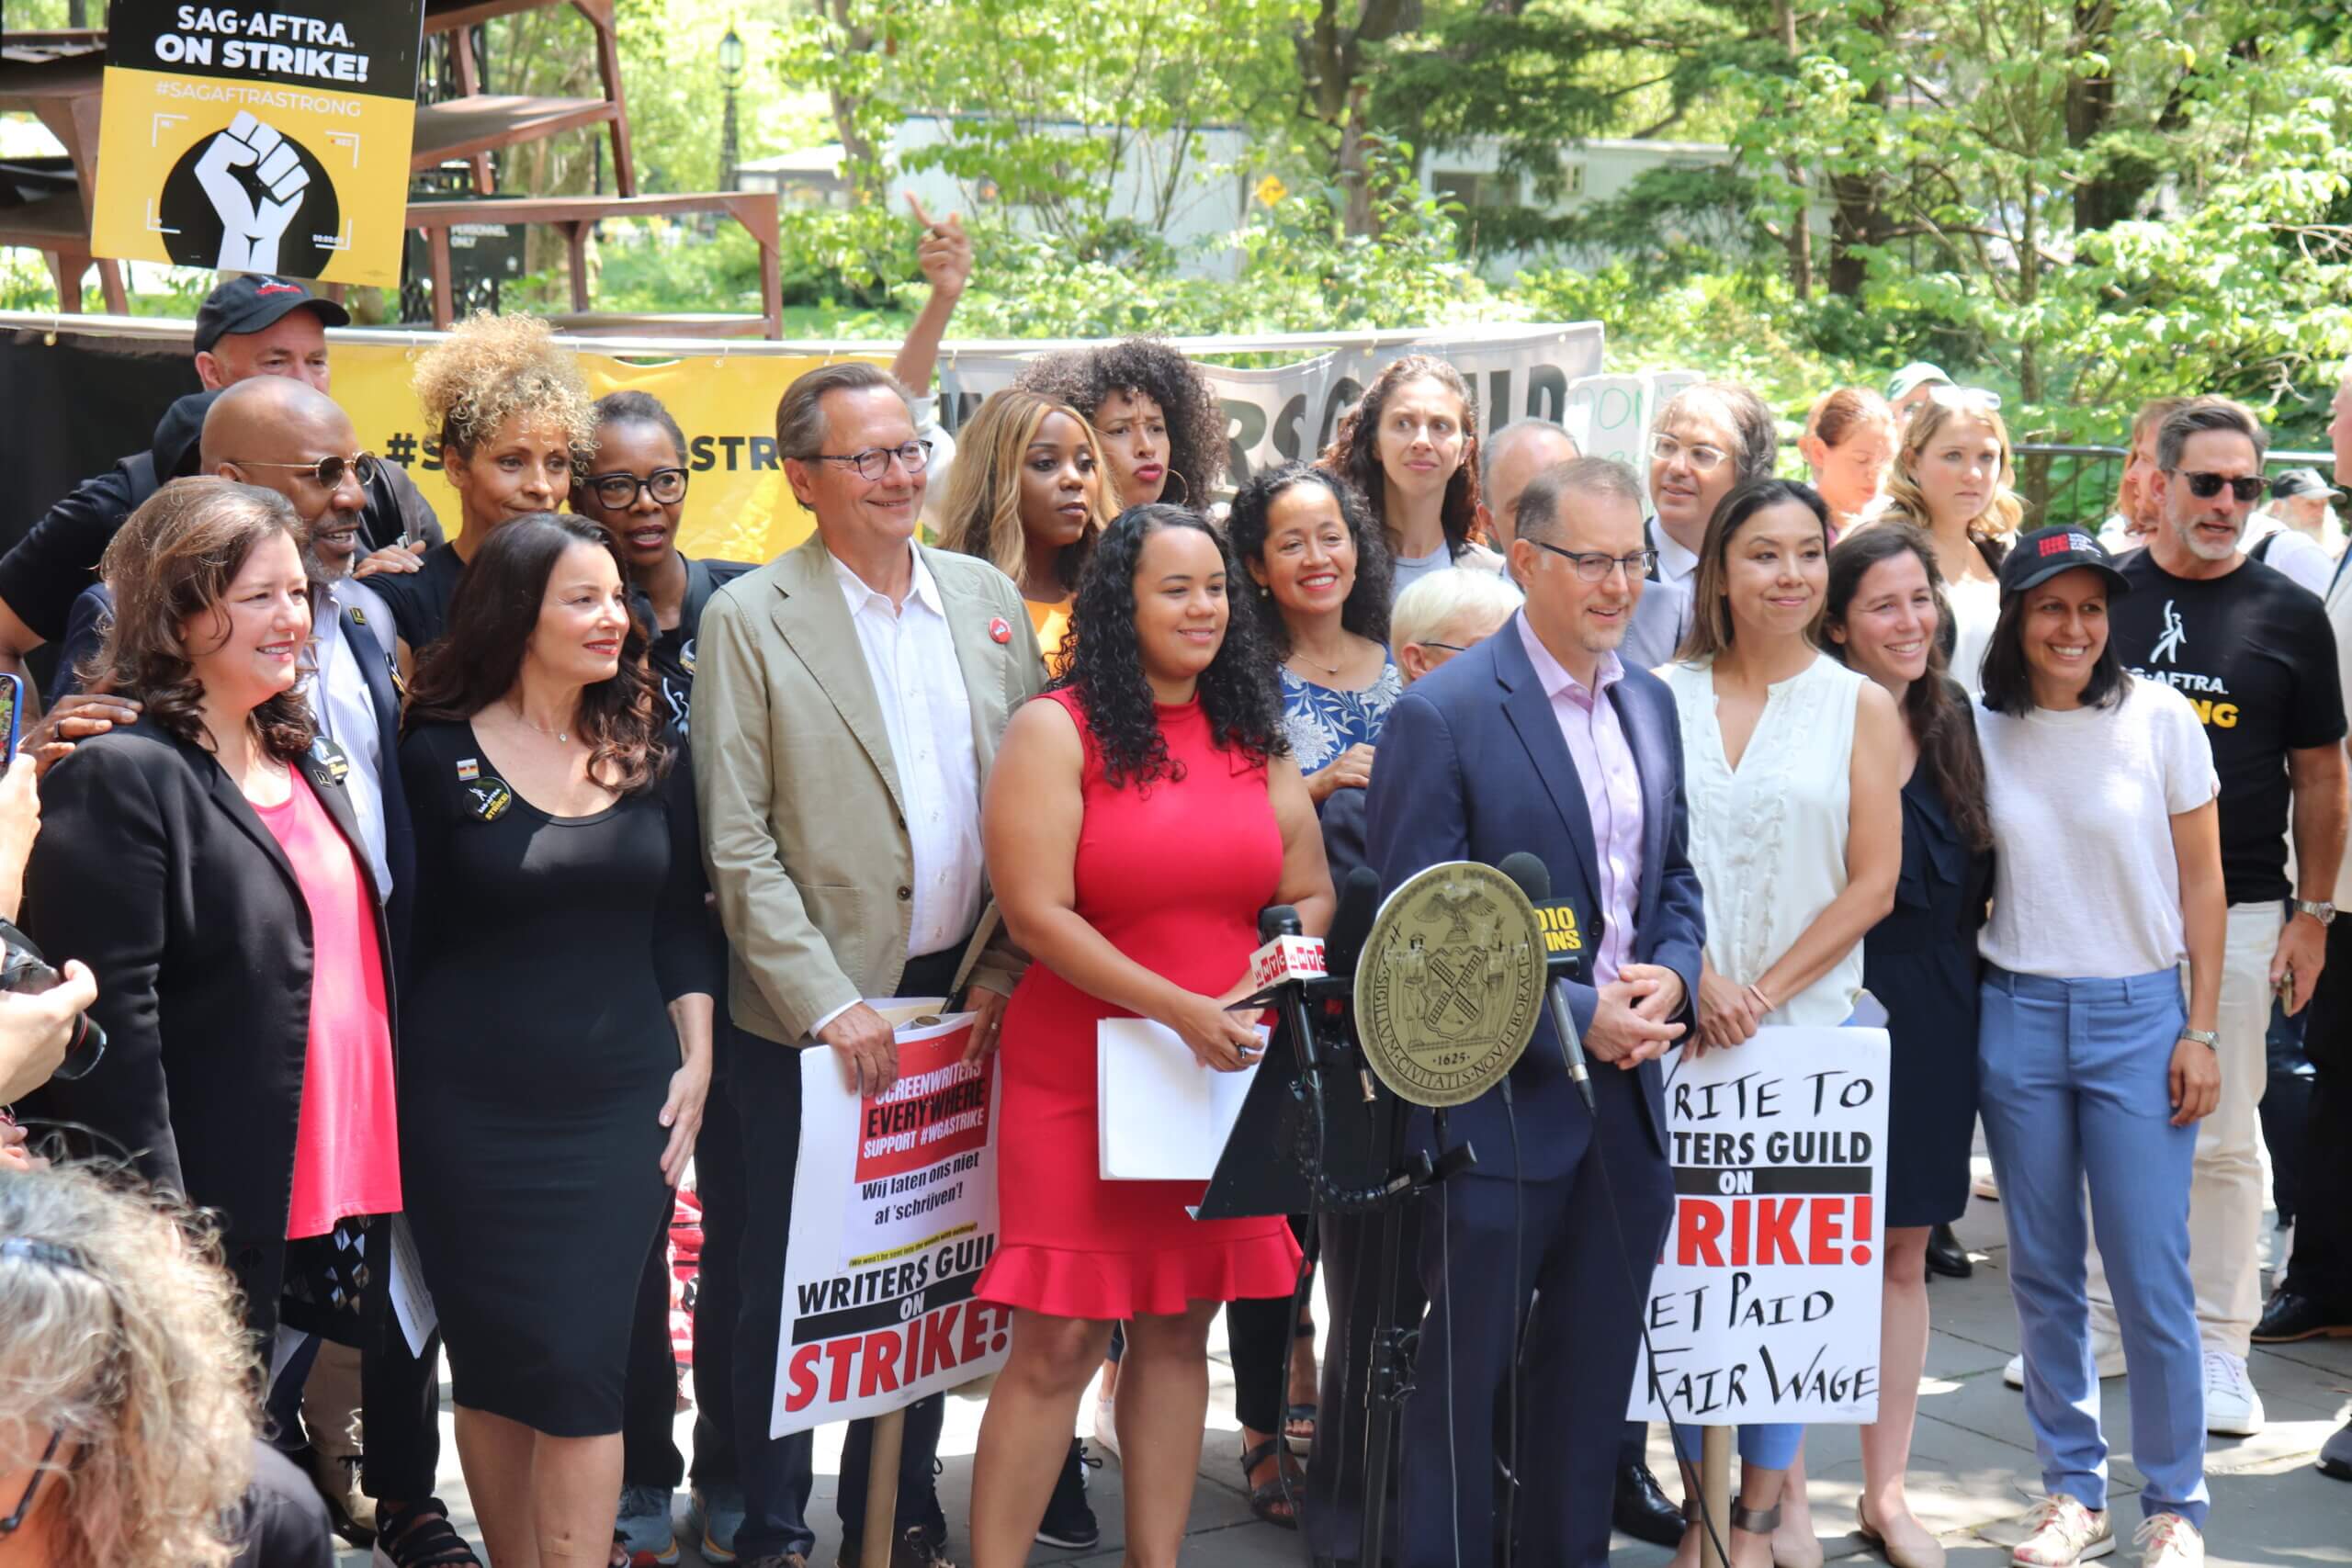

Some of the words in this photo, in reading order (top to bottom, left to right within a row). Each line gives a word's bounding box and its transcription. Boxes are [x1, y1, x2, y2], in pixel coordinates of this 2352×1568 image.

[155, 34, 212, 65] ON
[222, 41, 368, 83] STRIKE!
[155, 81, 361, 117] #SAGAFTRASTRONG
[1544, 930, 1581, 952] INS
[866, 1078, 985, 1138] EVERYWHERE
[1804, 1070, 1874, 1118] TO
[864, 1131, 917, 1158] SUPPORT
[920, 1108, 984, 1146] #WGASTRIKE
[1668, 1131, 1756, 1165] TERS
[1766, 1131, 1872, 1164] GUILD
[862, 1179, 888, 1201] Wij
[890, 1172, 926, 1194] laten
[929, 1162, 951, 1183] ons
[953, 1151, 979, 1174] niet
[1719, 1170, 1754, 1194] ON
[875, 1205, 890, 1225] af
[1657, 1196, 1873, 1267] RIKE!
[797, 1254, 929, 1315] WRITERS
[899, 1291, 924, 1322] ON
[1650, 1285, 1710, 1332] ET
[785, 1301, 1010, 1413] STRIKE!
[1758, 1344, 1878, 1404] WAGE
